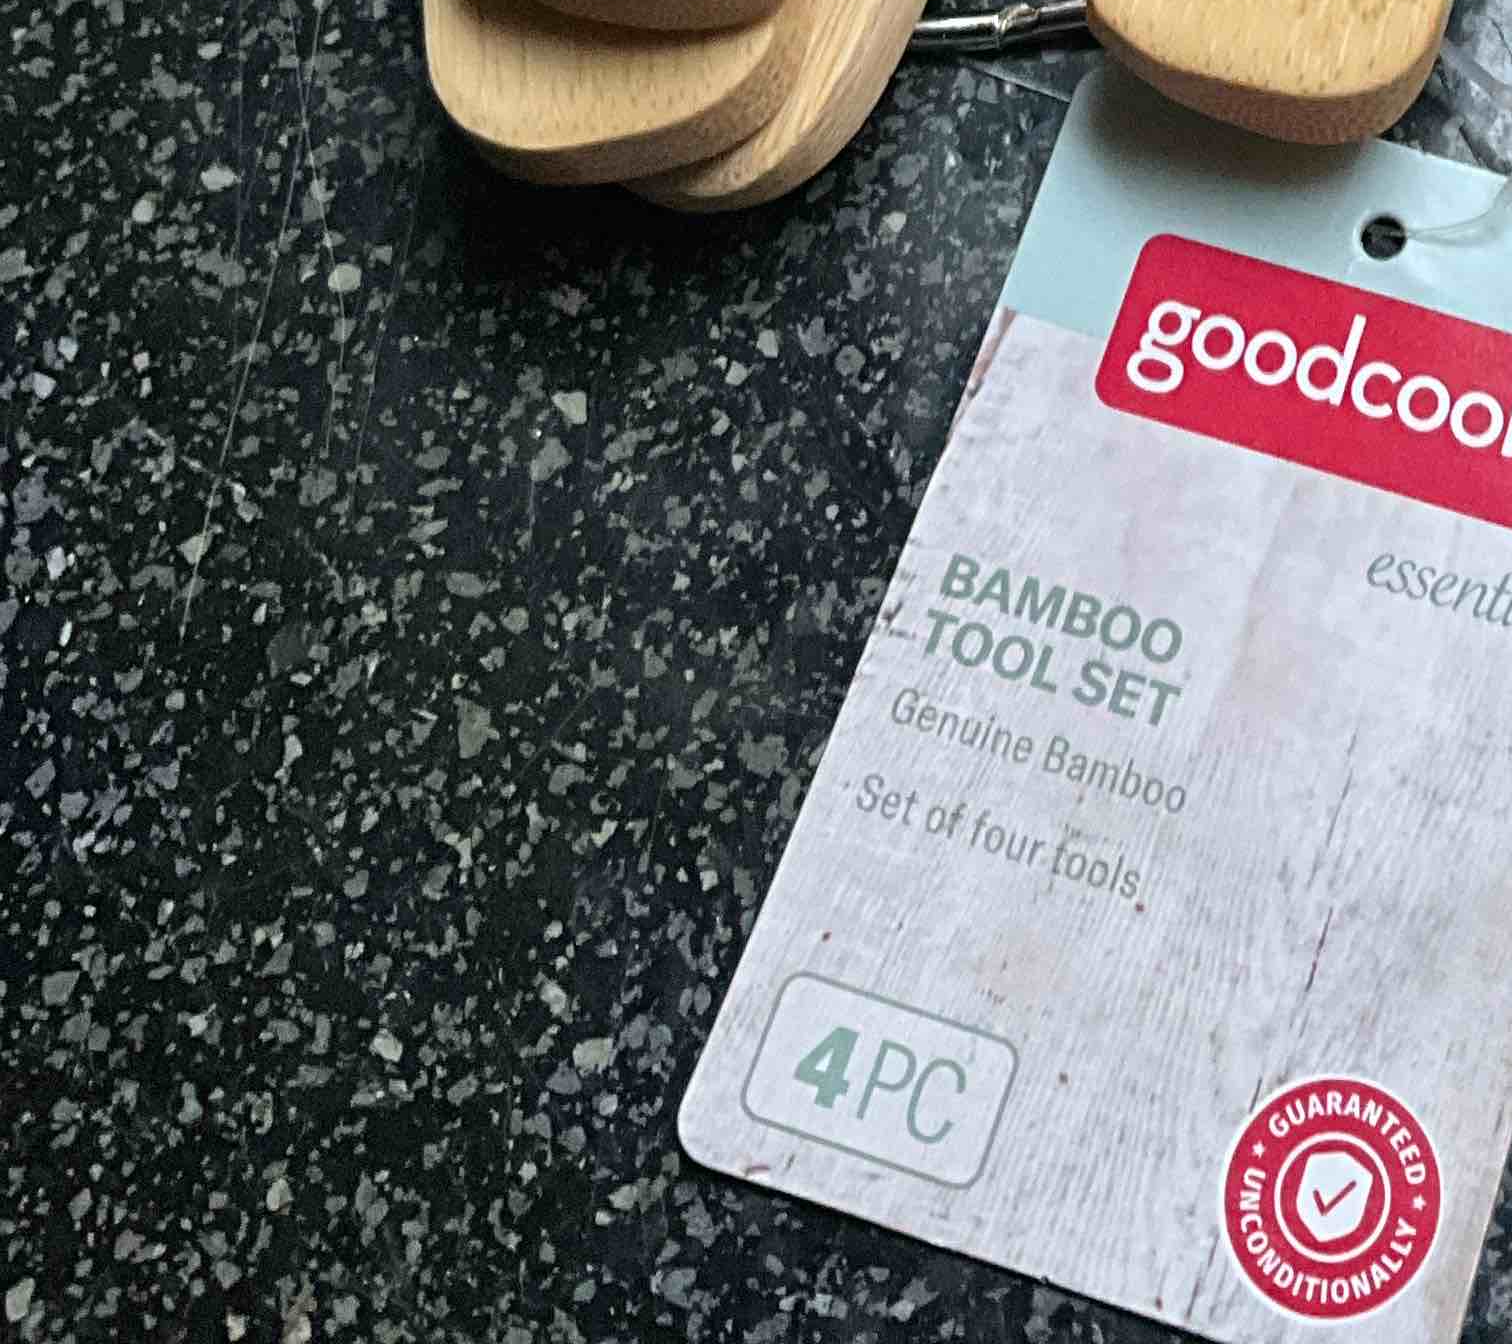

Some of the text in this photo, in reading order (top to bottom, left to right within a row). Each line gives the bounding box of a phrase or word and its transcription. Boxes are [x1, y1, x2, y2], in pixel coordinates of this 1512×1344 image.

[924, 608, 1183, 726] TOOL SET
[940, 553, 1183, 664] BAMBOO
[891, 687, 1187, 813] Genuine Bamboo
[856, 773, 1141, 899] Set of four tools
[1268, 1090, 1426, 1186] GUARANTEED
[1239, 1167, 1418, 1305] UNCONDITIONALLY
